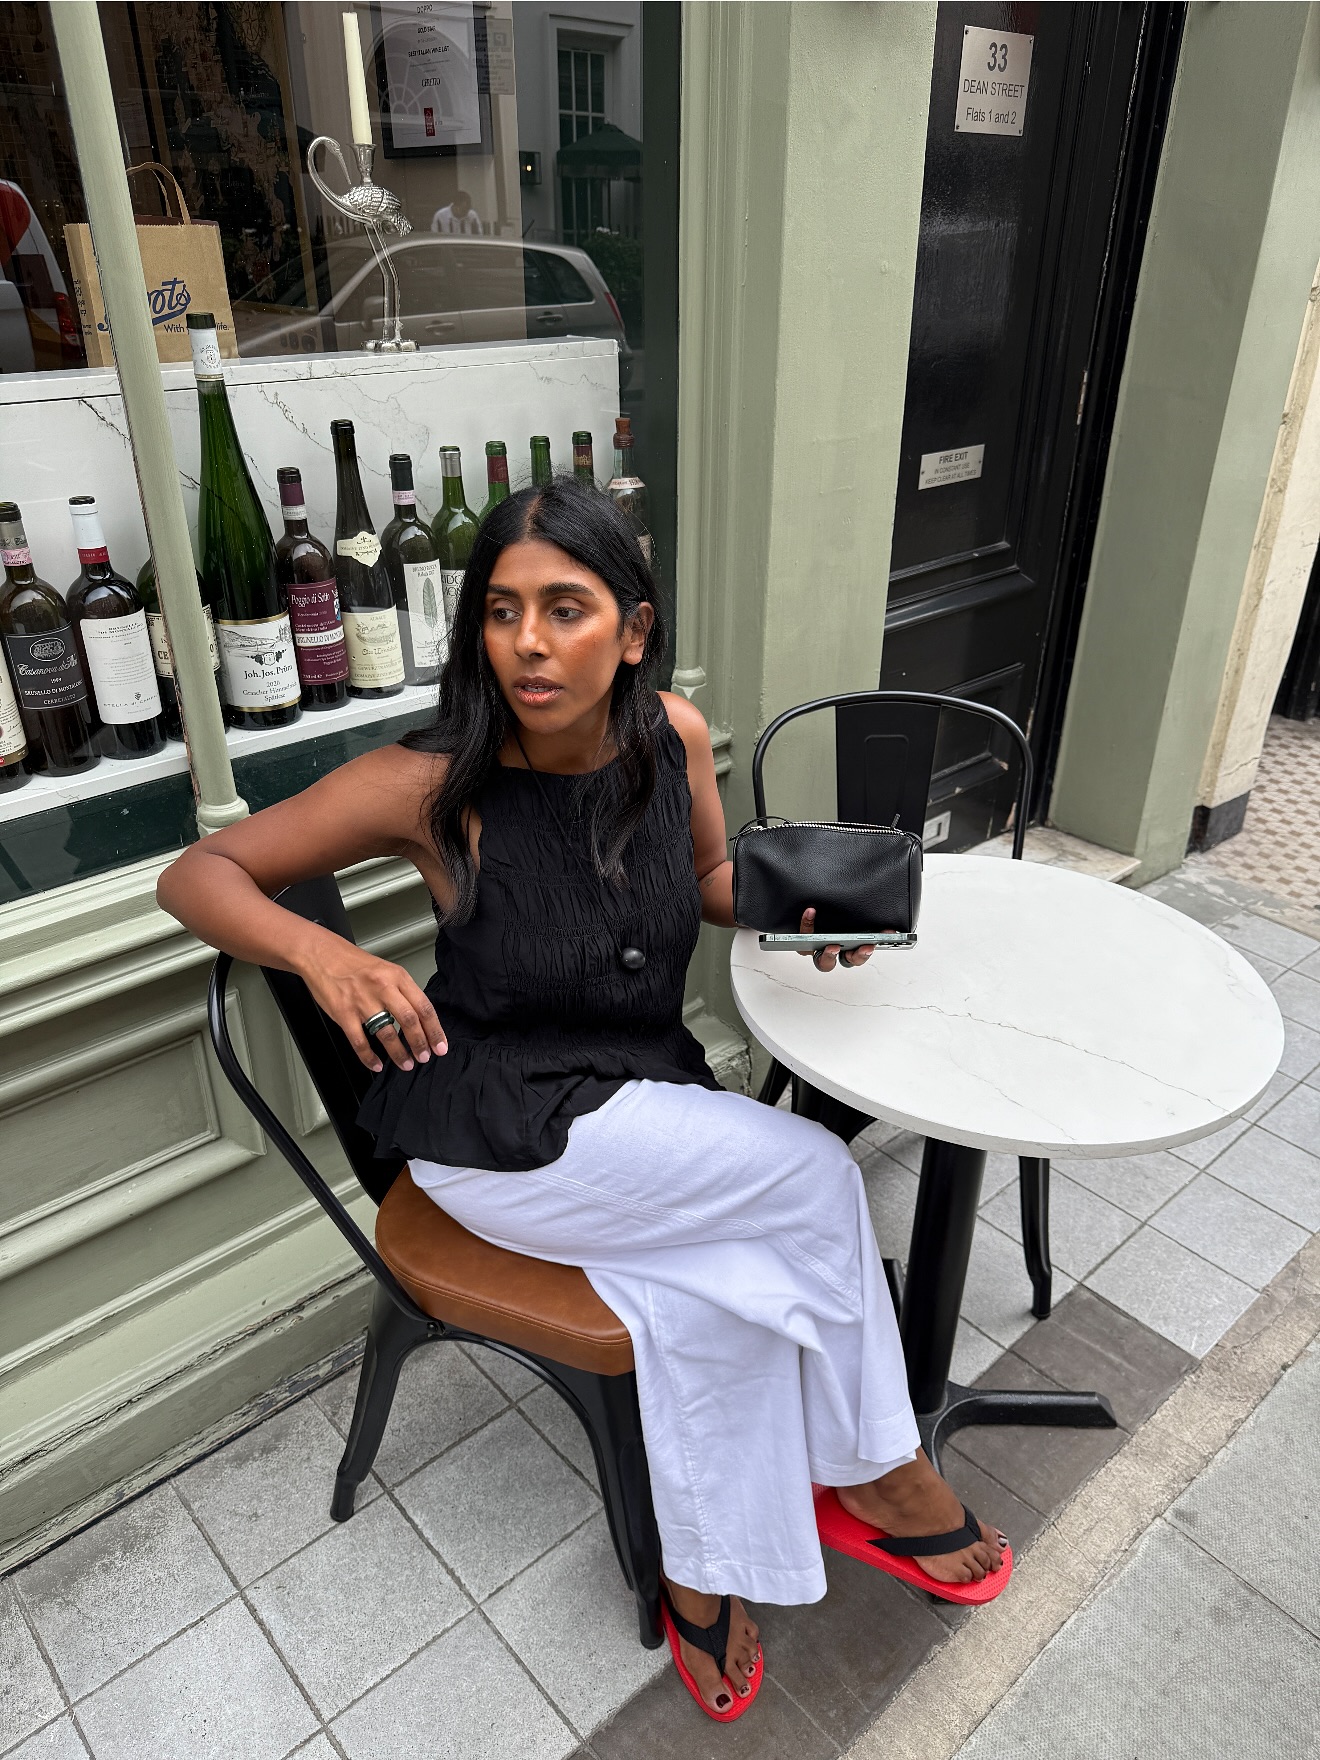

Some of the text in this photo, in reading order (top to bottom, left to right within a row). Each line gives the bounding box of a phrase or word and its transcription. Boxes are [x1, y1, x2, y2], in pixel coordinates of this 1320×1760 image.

[987, 41, 1009, 73] 33
[963, 79, 1025, 98] DEAN STREET
[965, 107, 1017, 125] Flats 1 and 2
[164, 324, 184, 334] With
[939, 452, 968, 465] FIRE EXIT
[939, 464, 961, 474] CONSTANT
[937, 474, 951, 483] CLEAR
[291, 594, 311, 608] Poggio
[244, 669, 261, 680] Joh.
[261, 669, 276, 680] Jos.
